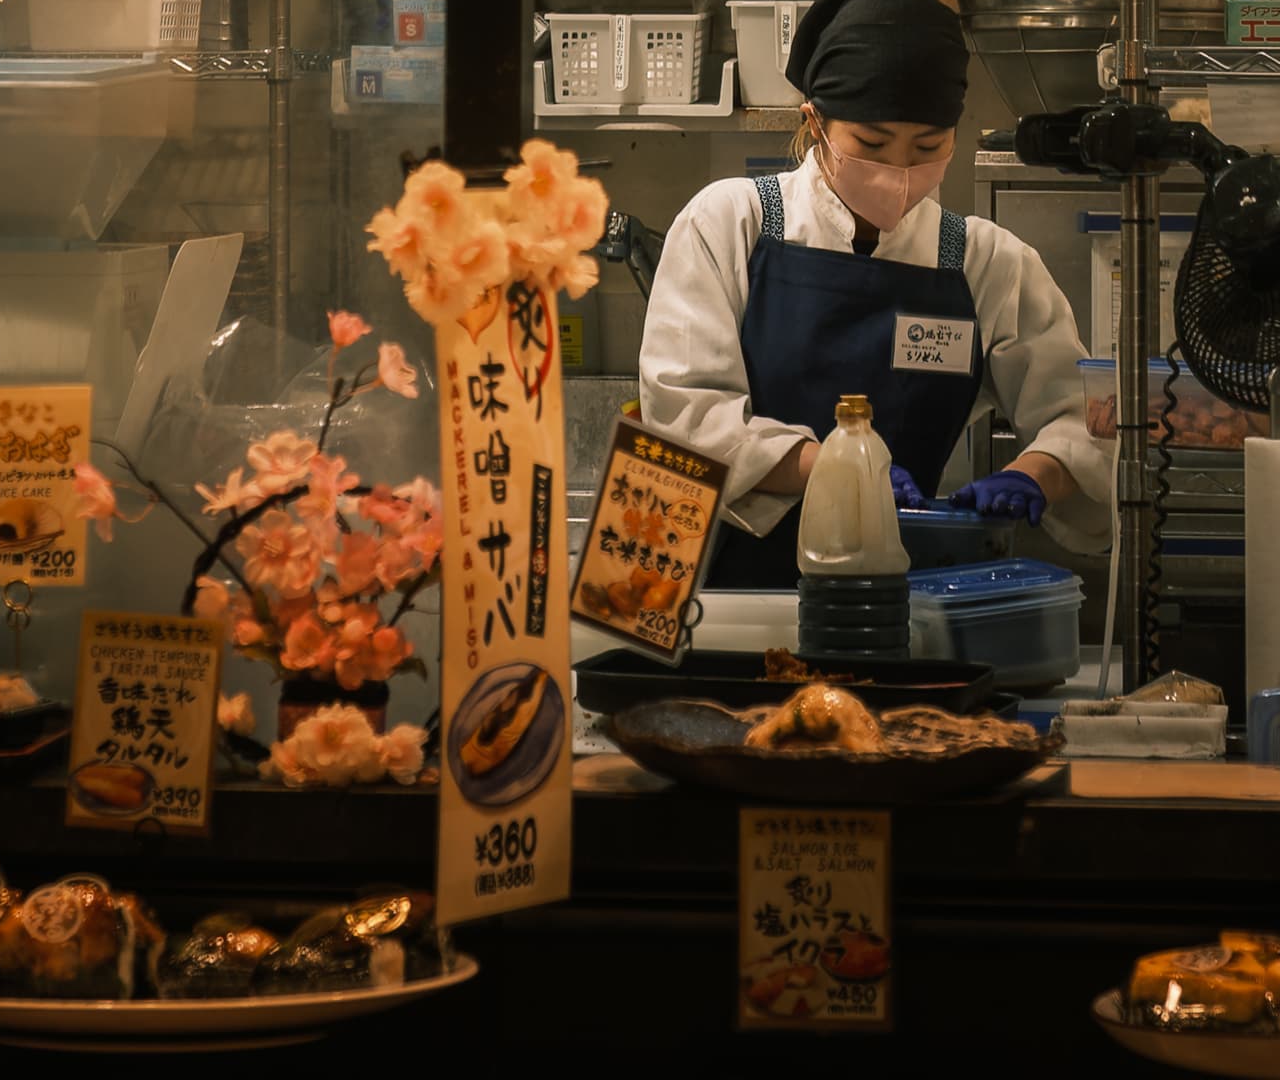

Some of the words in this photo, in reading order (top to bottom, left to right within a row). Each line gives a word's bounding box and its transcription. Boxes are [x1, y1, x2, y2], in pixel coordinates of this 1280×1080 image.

[362, 82, 376, 94] M
[22, 488, 52, 498] CAKE
[468, 352, 520, 647] 味噌サバ
[447, 361, 470, 536] MACKEREL
[464, 583, 478, 670] MISO
[31, 550, 75, 567] ¥200
[639, 608, 677, 634] ¥200
[91, 645, 144, 661] CHICKEN
[152, 650, 210, 666] TEMPURA
[97, 677, 196, 709] 香味だれ
[111, 705, 175, 740] 鶏天
[96, 739, 189, 770] タルタル
[152, 788, 201, 808] ¥390
[475, 818, 537, 865] ¥360
[770, 842, 828, 857] SALMON
[817, 858, 876, 872] SALMON
